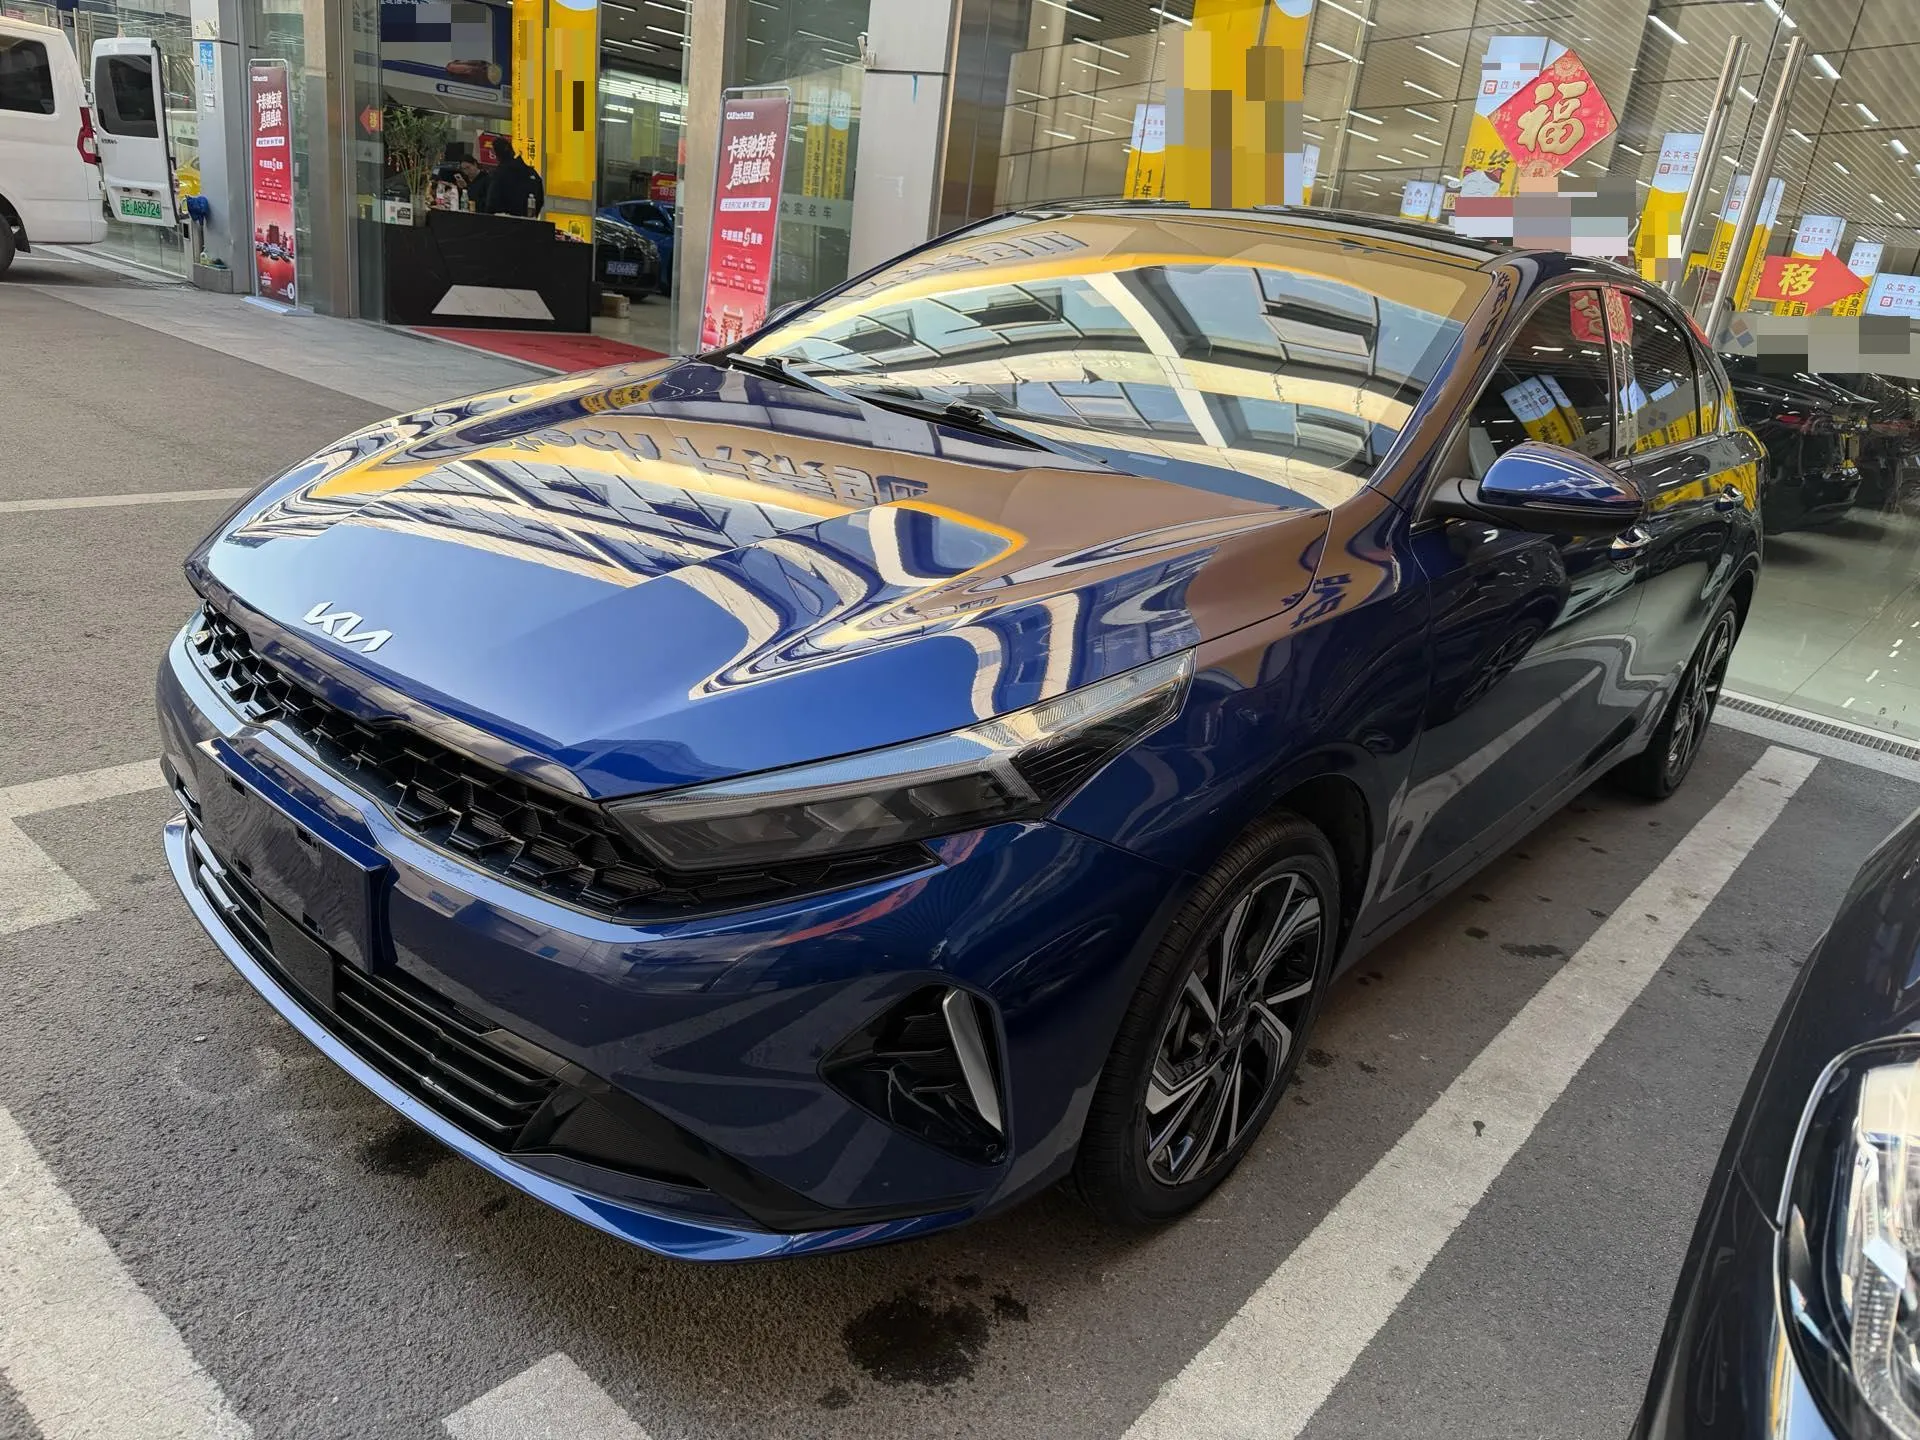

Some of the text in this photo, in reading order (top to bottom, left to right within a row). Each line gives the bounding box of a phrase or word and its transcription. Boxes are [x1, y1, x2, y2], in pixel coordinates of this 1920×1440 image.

[1517, 80, 1589, 155] 福
[727, 131, 777, 163] 卡泰驰年度
[725, 158, 771, 190] 感恩盛典
[1779, 263, 1818, 296] 移
[1885, 282, 1920, 294] 众实名
[303, 600, 393, 653] KIA
